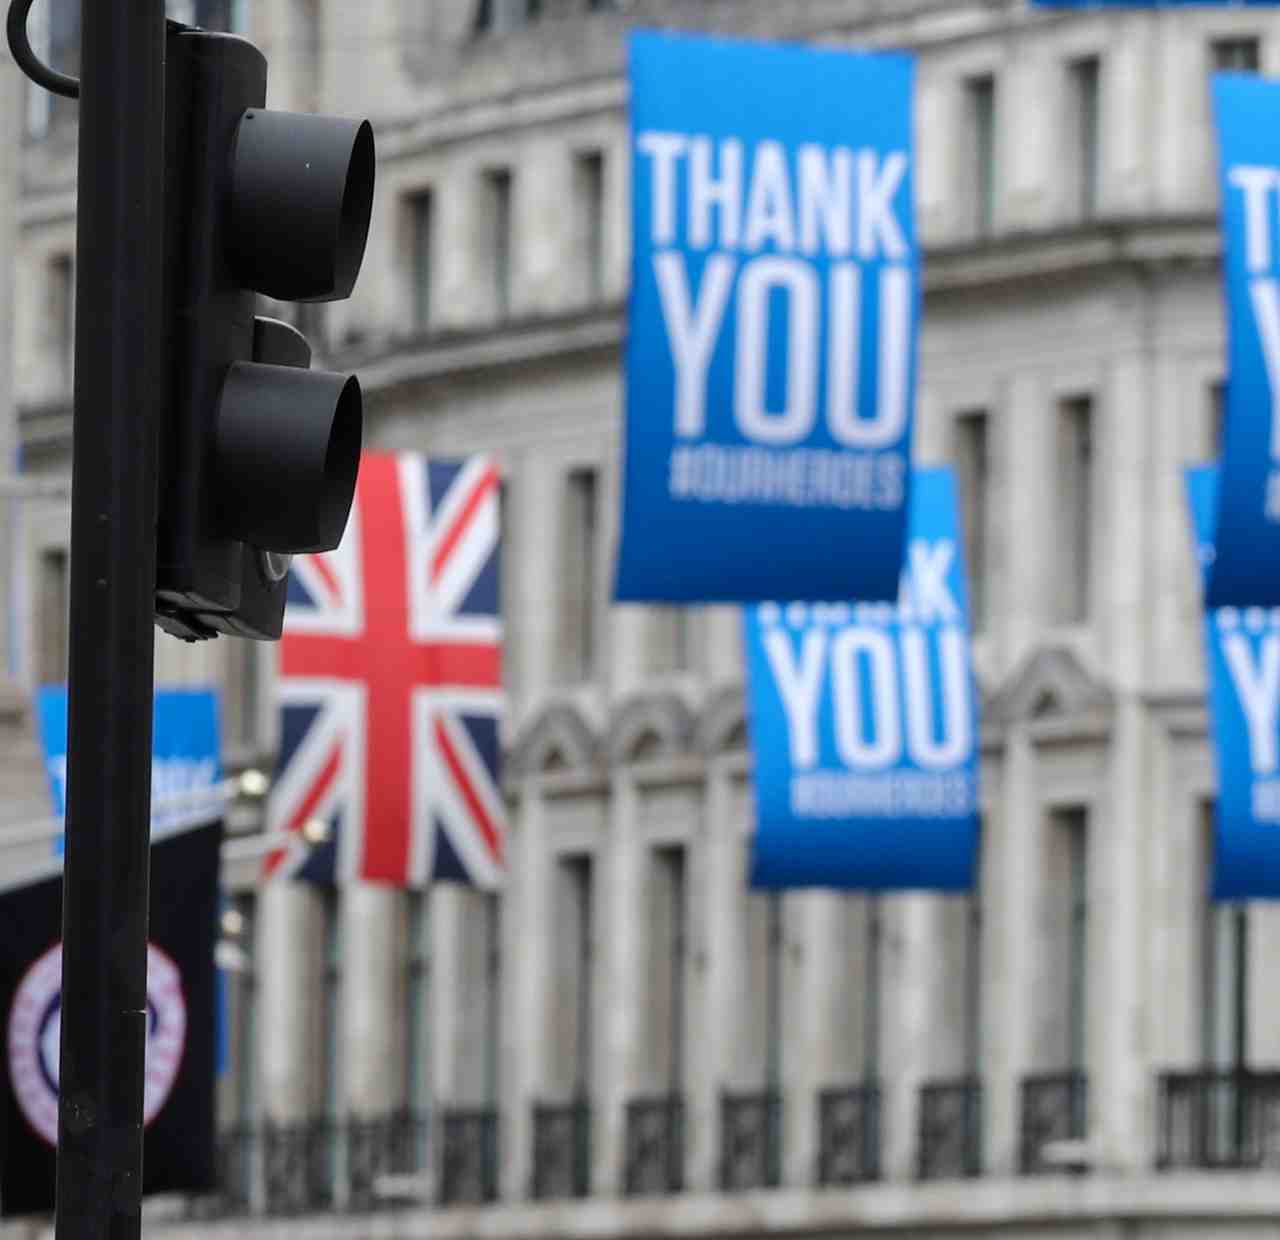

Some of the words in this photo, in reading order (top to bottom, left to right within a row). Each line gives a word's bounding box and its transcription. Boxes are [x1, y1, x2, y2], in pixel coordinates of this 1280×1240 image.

[638, 132, 909, 257] THANK
[654, 250, 911, 448] YOU
[763, 624, 974, 770] YOU
